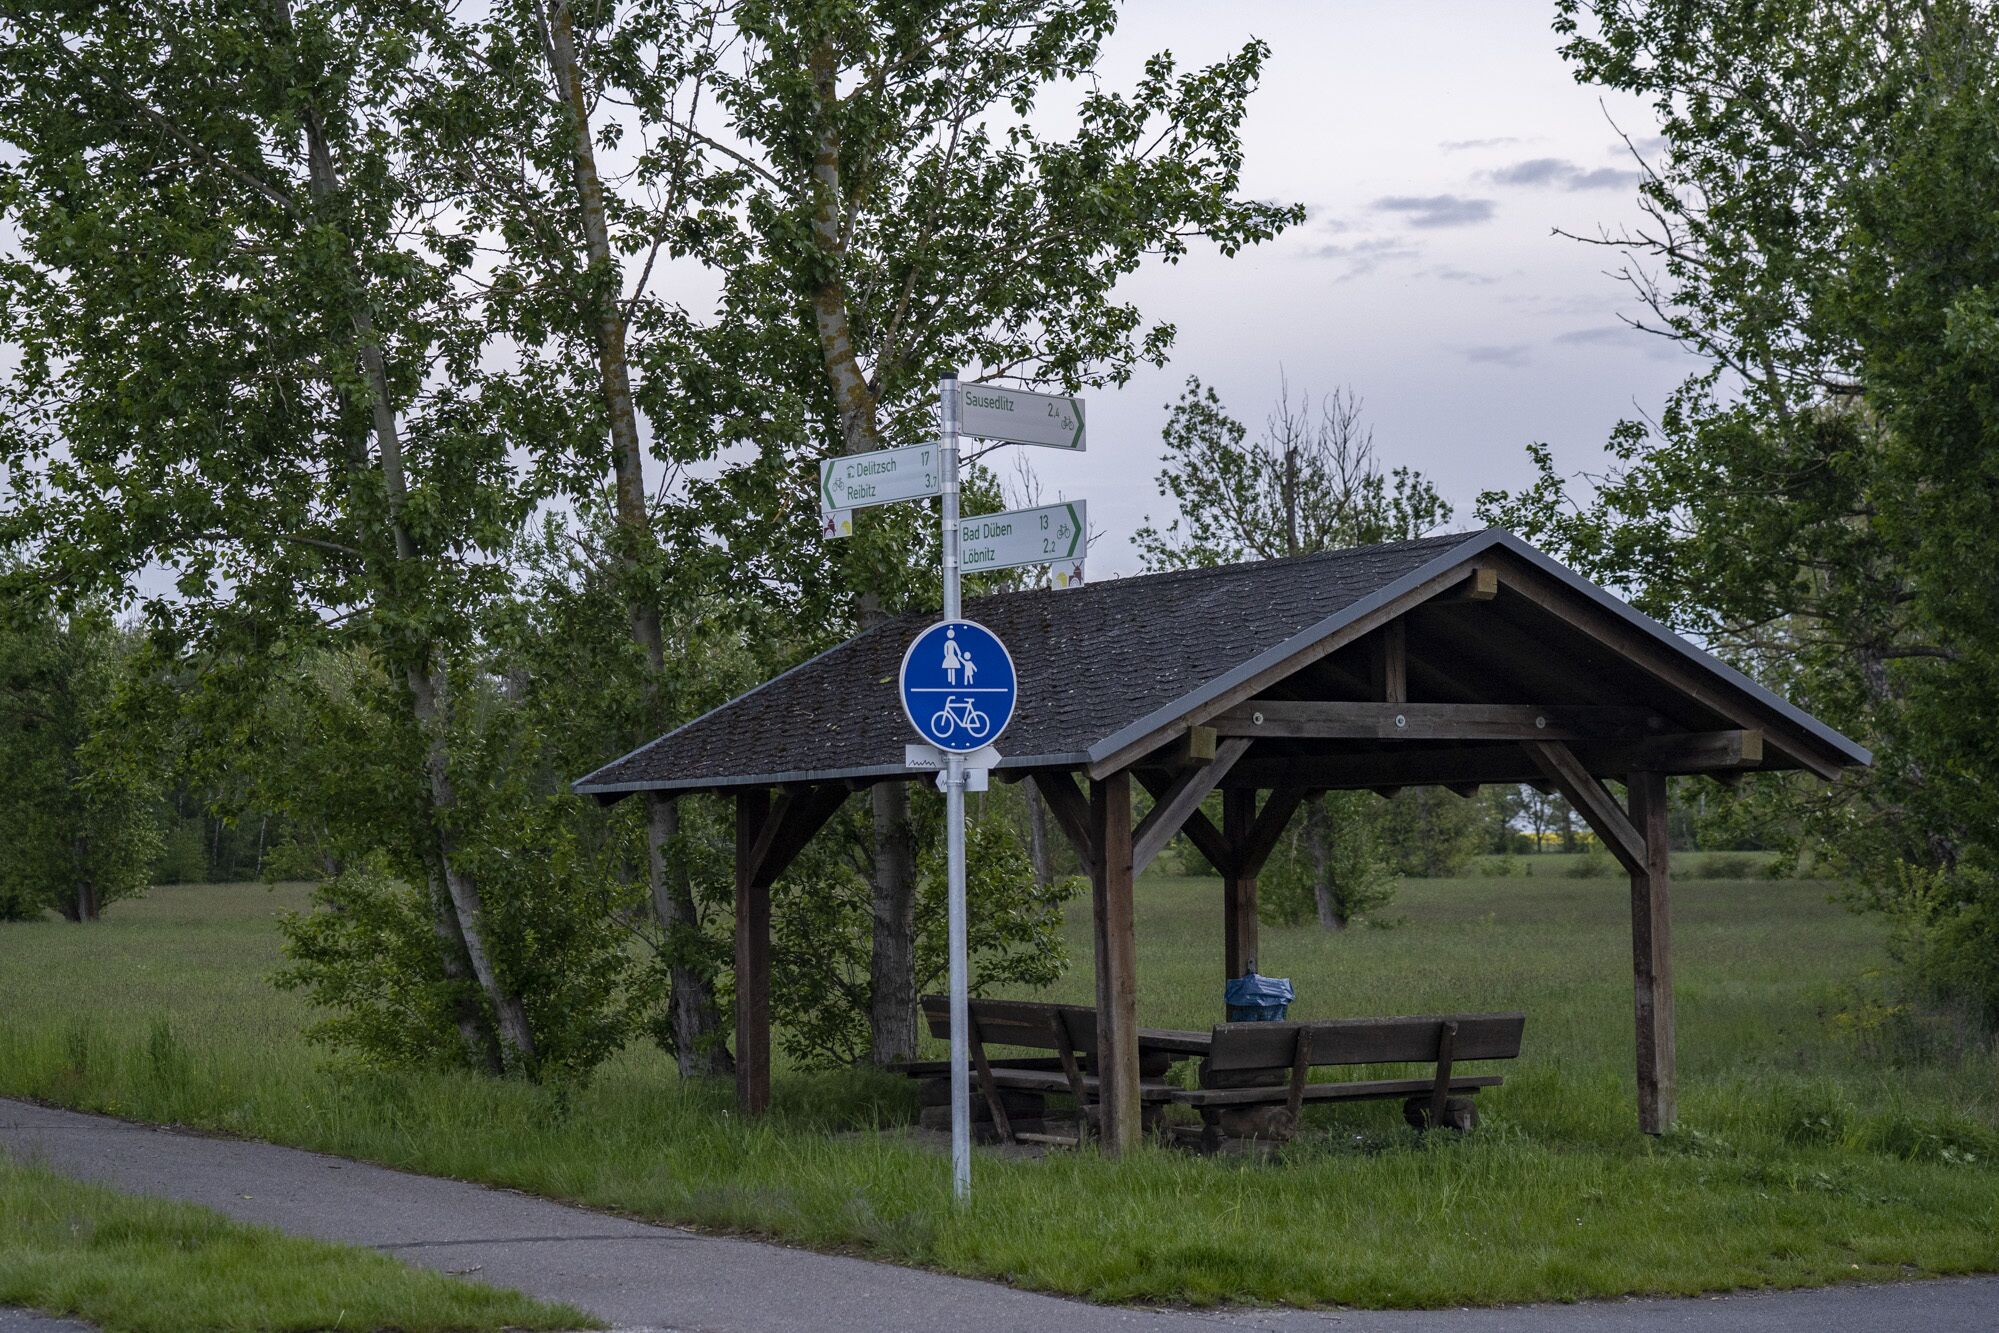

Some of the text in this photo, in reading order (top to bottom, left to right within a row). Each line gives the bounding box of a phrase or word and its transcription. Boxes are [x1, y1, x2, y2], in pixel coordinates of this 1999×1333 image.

[965, 391, 1015, 412] Sausedlitz
[856, 451, 930, 477] Delitzsch 17
[847, 484, 876, 500] Reibitz
[963, 514, 1049, 542] Bad Düben 13
[963, 547, 995, 565] Löbnitz
